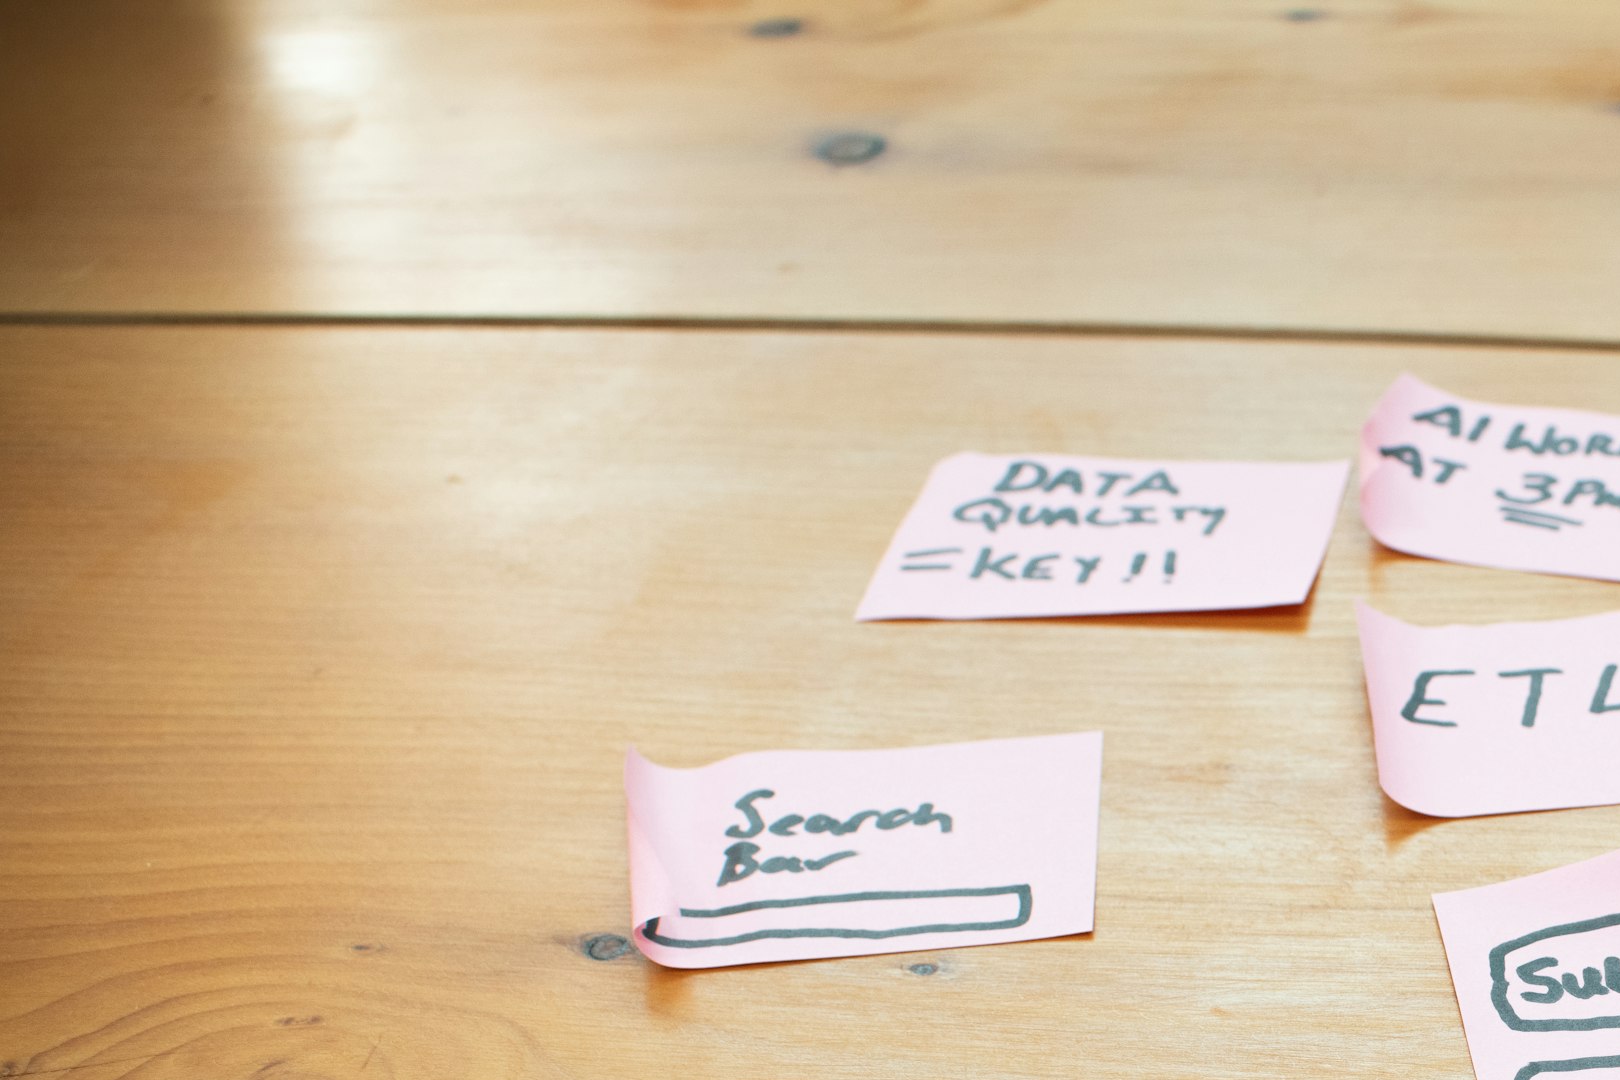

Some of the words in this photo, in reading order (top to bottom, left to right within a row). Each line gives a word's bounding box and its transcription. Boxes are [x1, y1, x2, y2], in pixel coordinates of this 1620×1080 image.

[1412, 404, 1491, 443] AI
[994, 460, 1179, 497] DATA
[1378, 444, 1466, 485] AT
[952, 498, 1226, 536] QUALITY
[724, 788, 953, 840] Search
[716, 841, 859, 888] Bar
